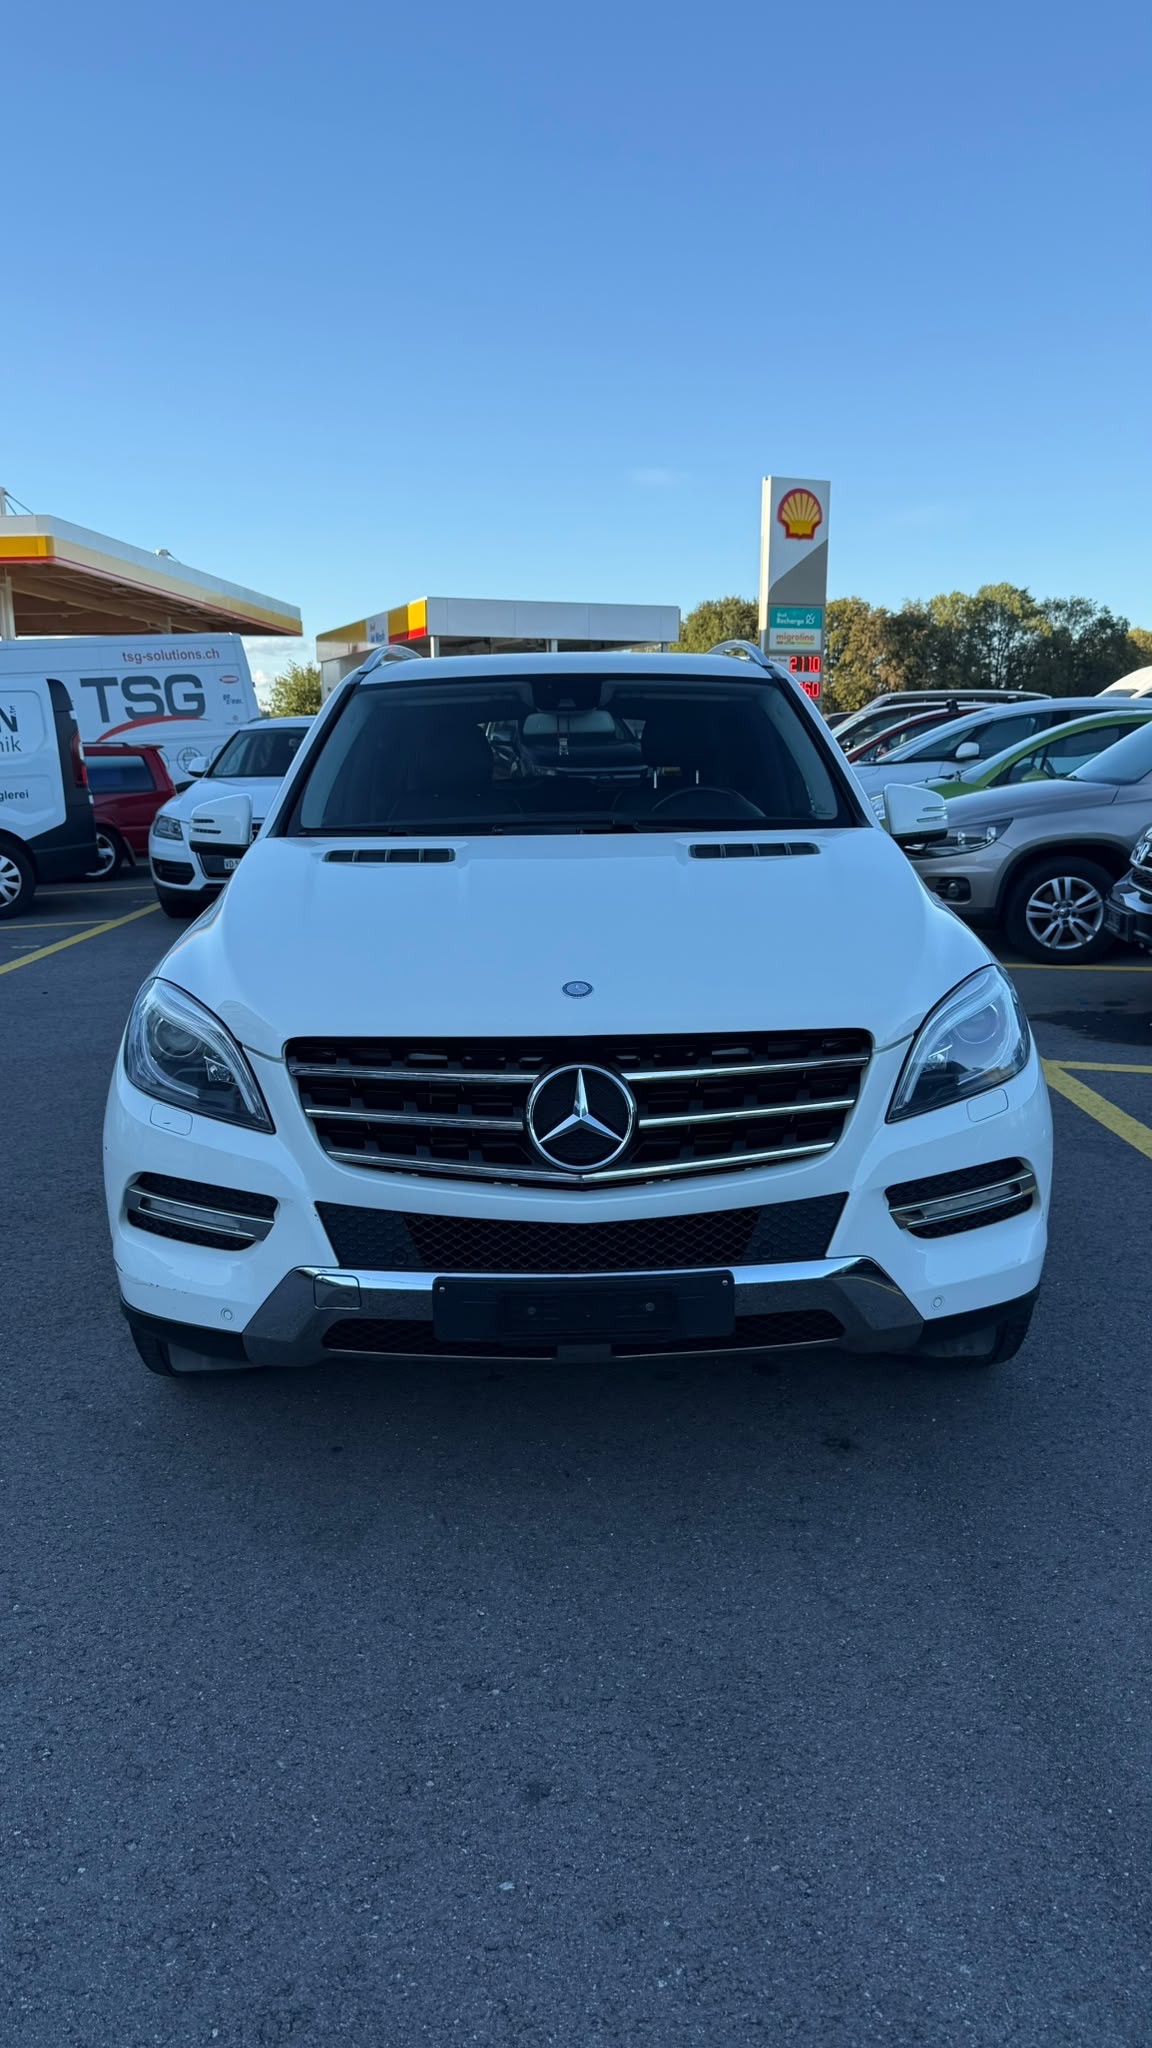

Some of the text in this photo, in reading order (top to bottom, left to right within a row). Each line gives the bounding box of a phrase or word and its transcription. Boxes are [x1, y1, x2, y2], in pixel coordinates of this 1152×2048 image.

[776, 617, 804, 626] Recharge
[776, 632, 815, 642] migrolino
[122, 648, 220, 665] tsg-solutions.ch
[80, 674, 206, 723] TSG
